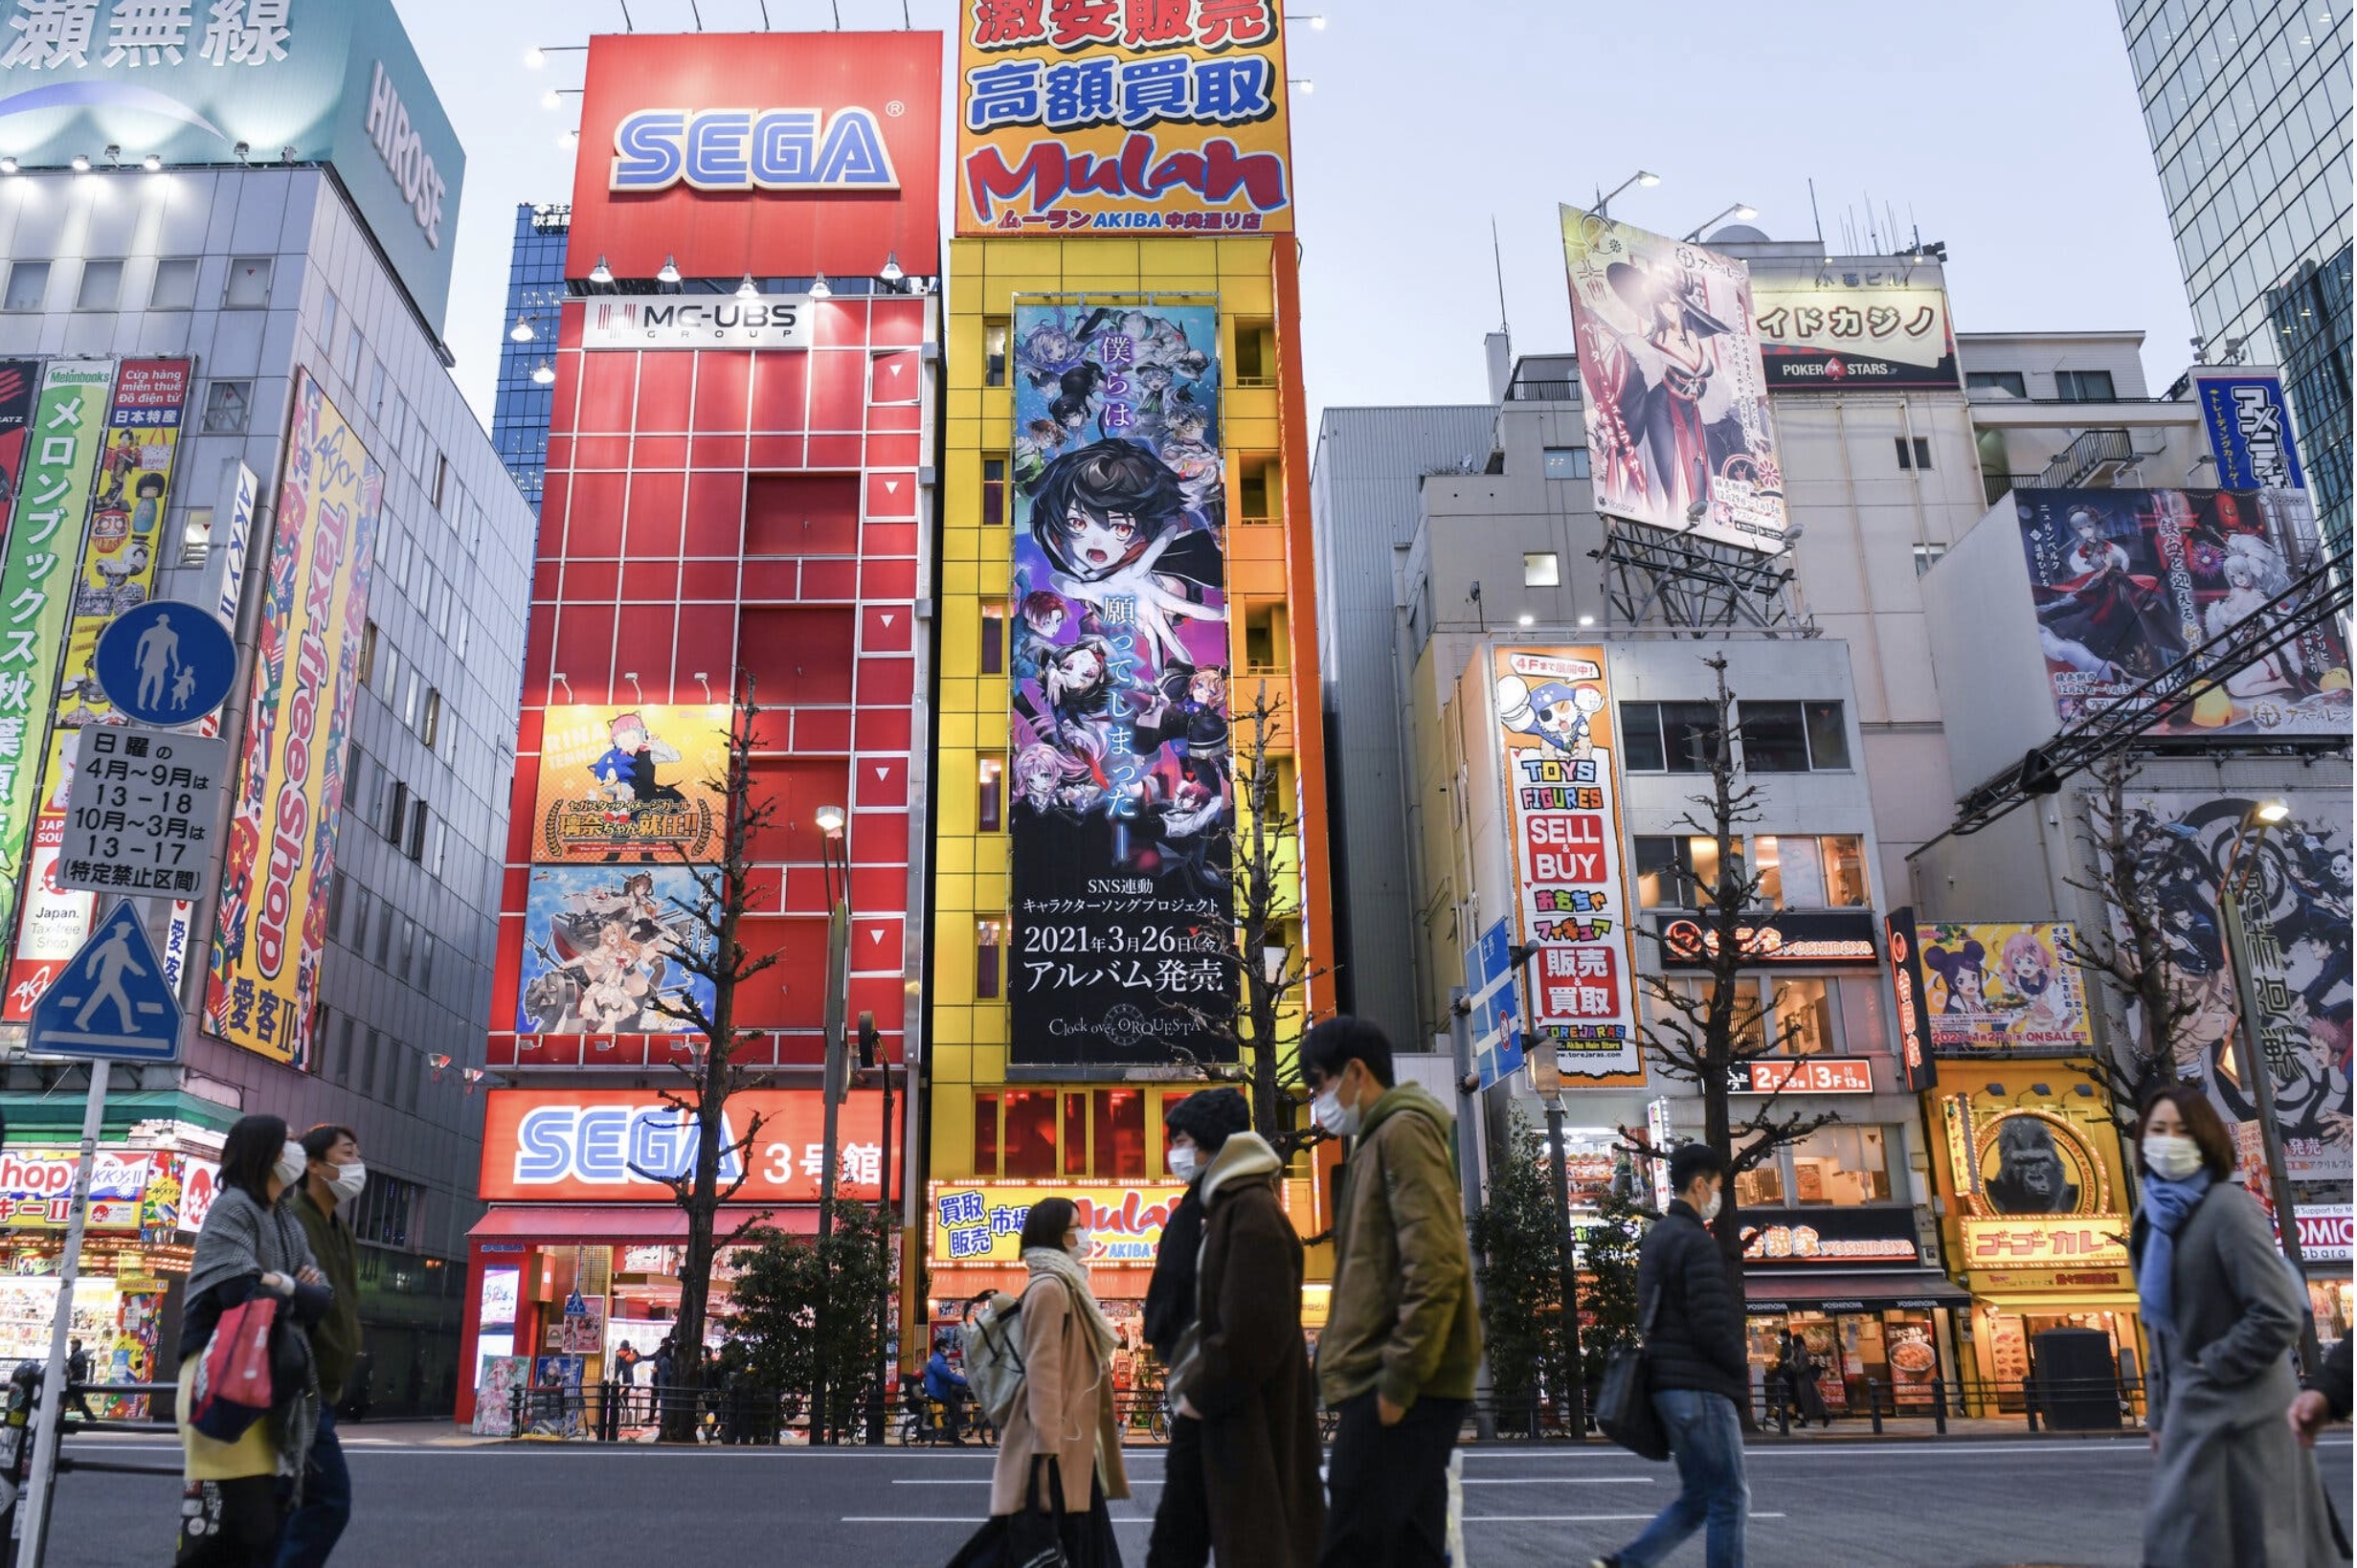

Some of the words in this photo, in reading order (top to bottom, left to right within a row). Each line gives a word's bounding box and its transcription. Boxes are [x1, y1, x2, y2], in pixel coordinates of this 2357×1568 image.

[1, 0, 291, 70] 瀬無線
[969, 56, 1268, 127] 高額買取
[365, 58, 446, 251] HIROSE
[610, 106, 901, 191] SEGA
[966, 132, 1288, 222] Mulan
[998, 210, 1091, 229] ムーラン
[1093, 213, 1162, 228] AKIBA
[1164, 211, 1263, 230] 中央通り店
[643, 303, 797, 328] MC-UBS
[1756, 305, 1934, 338] イドカジノ
[51, 370, 110, 383] Melonbooks
[1101, 336, 1132, 427] 僕らは
[1783, 364, 1825, 376] POKER
[1848, 363, 1888, 375] STARS
[115, 410, 177, 423] 日本特産
[0, 396, 82, 839] メロンブックス秋葉原
[94, 732, 172, 760] 日曜の
[1521, 760, 1596, 782] TOYS
[1520, 787, 1604, 810] FIGURES
[36, 833, 63, 843] SOU
[39, 819, 64, 831] JAP
[1530, 818, 1600, 844] SELL
[62, 858, 201, 892] (特定禁止区間)
[1536, 853, 1598, 880] BUY
[1088, 878, 1154, 895] SNS連動
[1023, 898, 1220, 913] キャラクターソングプロジェクト
[1535, 889, 1607, 912] おもちゃ
[35, 907, 79, 921] Japan.
[1023, 925, 1224, 954] 2021年3月26日(金)
[1534, 917, 1612, 942] フィギュア
[1783, 940, 1874, 956] YOSHINOYA
[1023, 958, 1224, 993] アルバム発売
[1547, 949, 1608, 978] 販売
[1548, 986, 1612, 1016] 買取
[1048, 1018, 1088, 1036] Clock
[1090, 1022, 1116, 1036] over
[1756, 1066, 1782, 1087] 2F
[1815, 1065, 1841, 1088] 3F
[513, 1104, 747, 1185] SEGA
[1, 1157, 69, 1194] hop
[91, 1168, 130, 1184] KKY
[763, 1142, 883, 1185] 3号館
[938, 1190, 984, 1224] 買取
[990, 1205, 1031, 1234] 市場
[1073, 1190, 1183, 1236] ula
[2301, 1206, 2330, 1215] Support
[949, 1224, 992, 1258] 販売
[1108, 1243, 1151, 1258] AKIBA
[1821, 1240, 1915, 1256] YOSHINOYA
[1976, 1229, 2121, 1256] ゴーゴーカレー
[2301, 1247, 2347, 1259] abara
